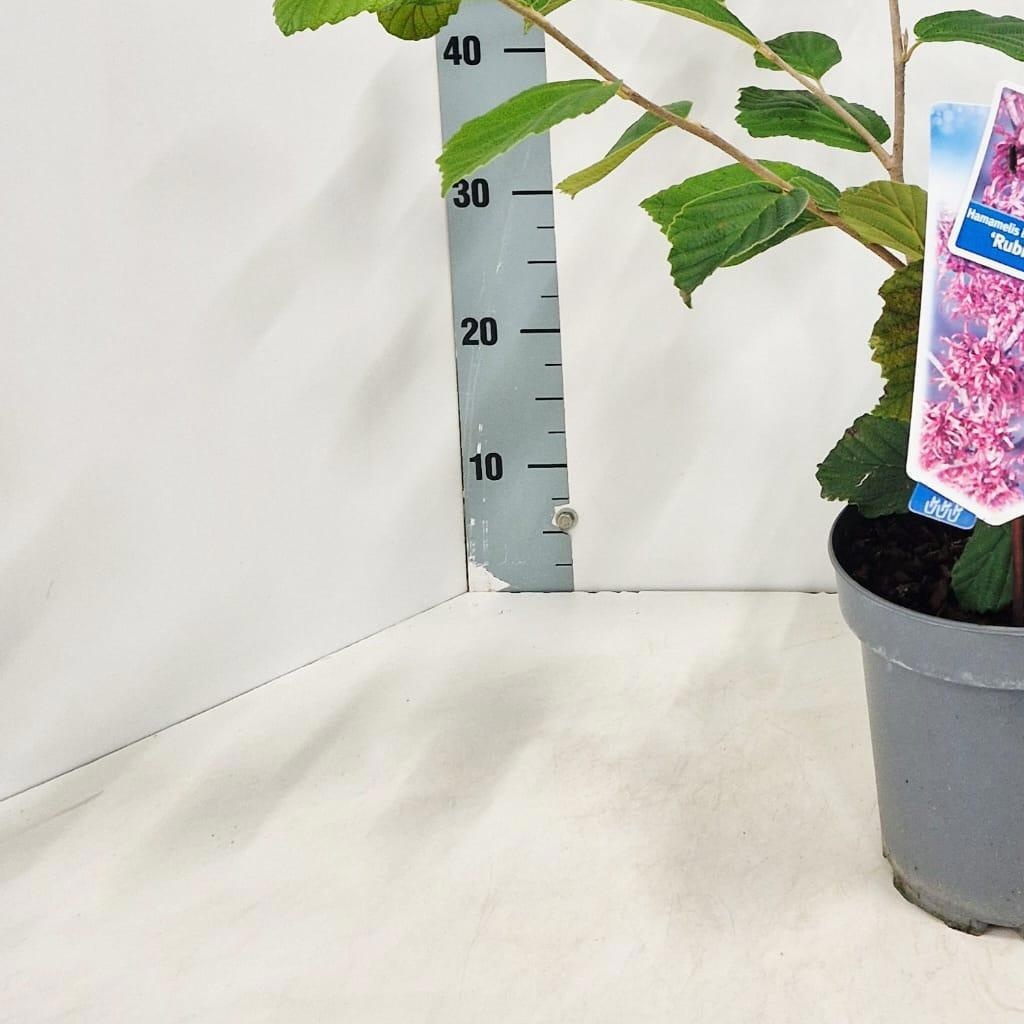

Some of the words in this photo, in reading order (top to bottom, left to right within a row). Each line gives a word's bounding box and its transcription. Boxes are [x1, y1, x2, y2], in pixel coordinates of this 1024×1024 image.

[443, 35, 482, 66] 40
[452, 178, 490, 208] 30
[966, 207, 1020, 236] Hamamelis
[461, 317, 498, 345] 20
[469, 452, 503, 481] 10
